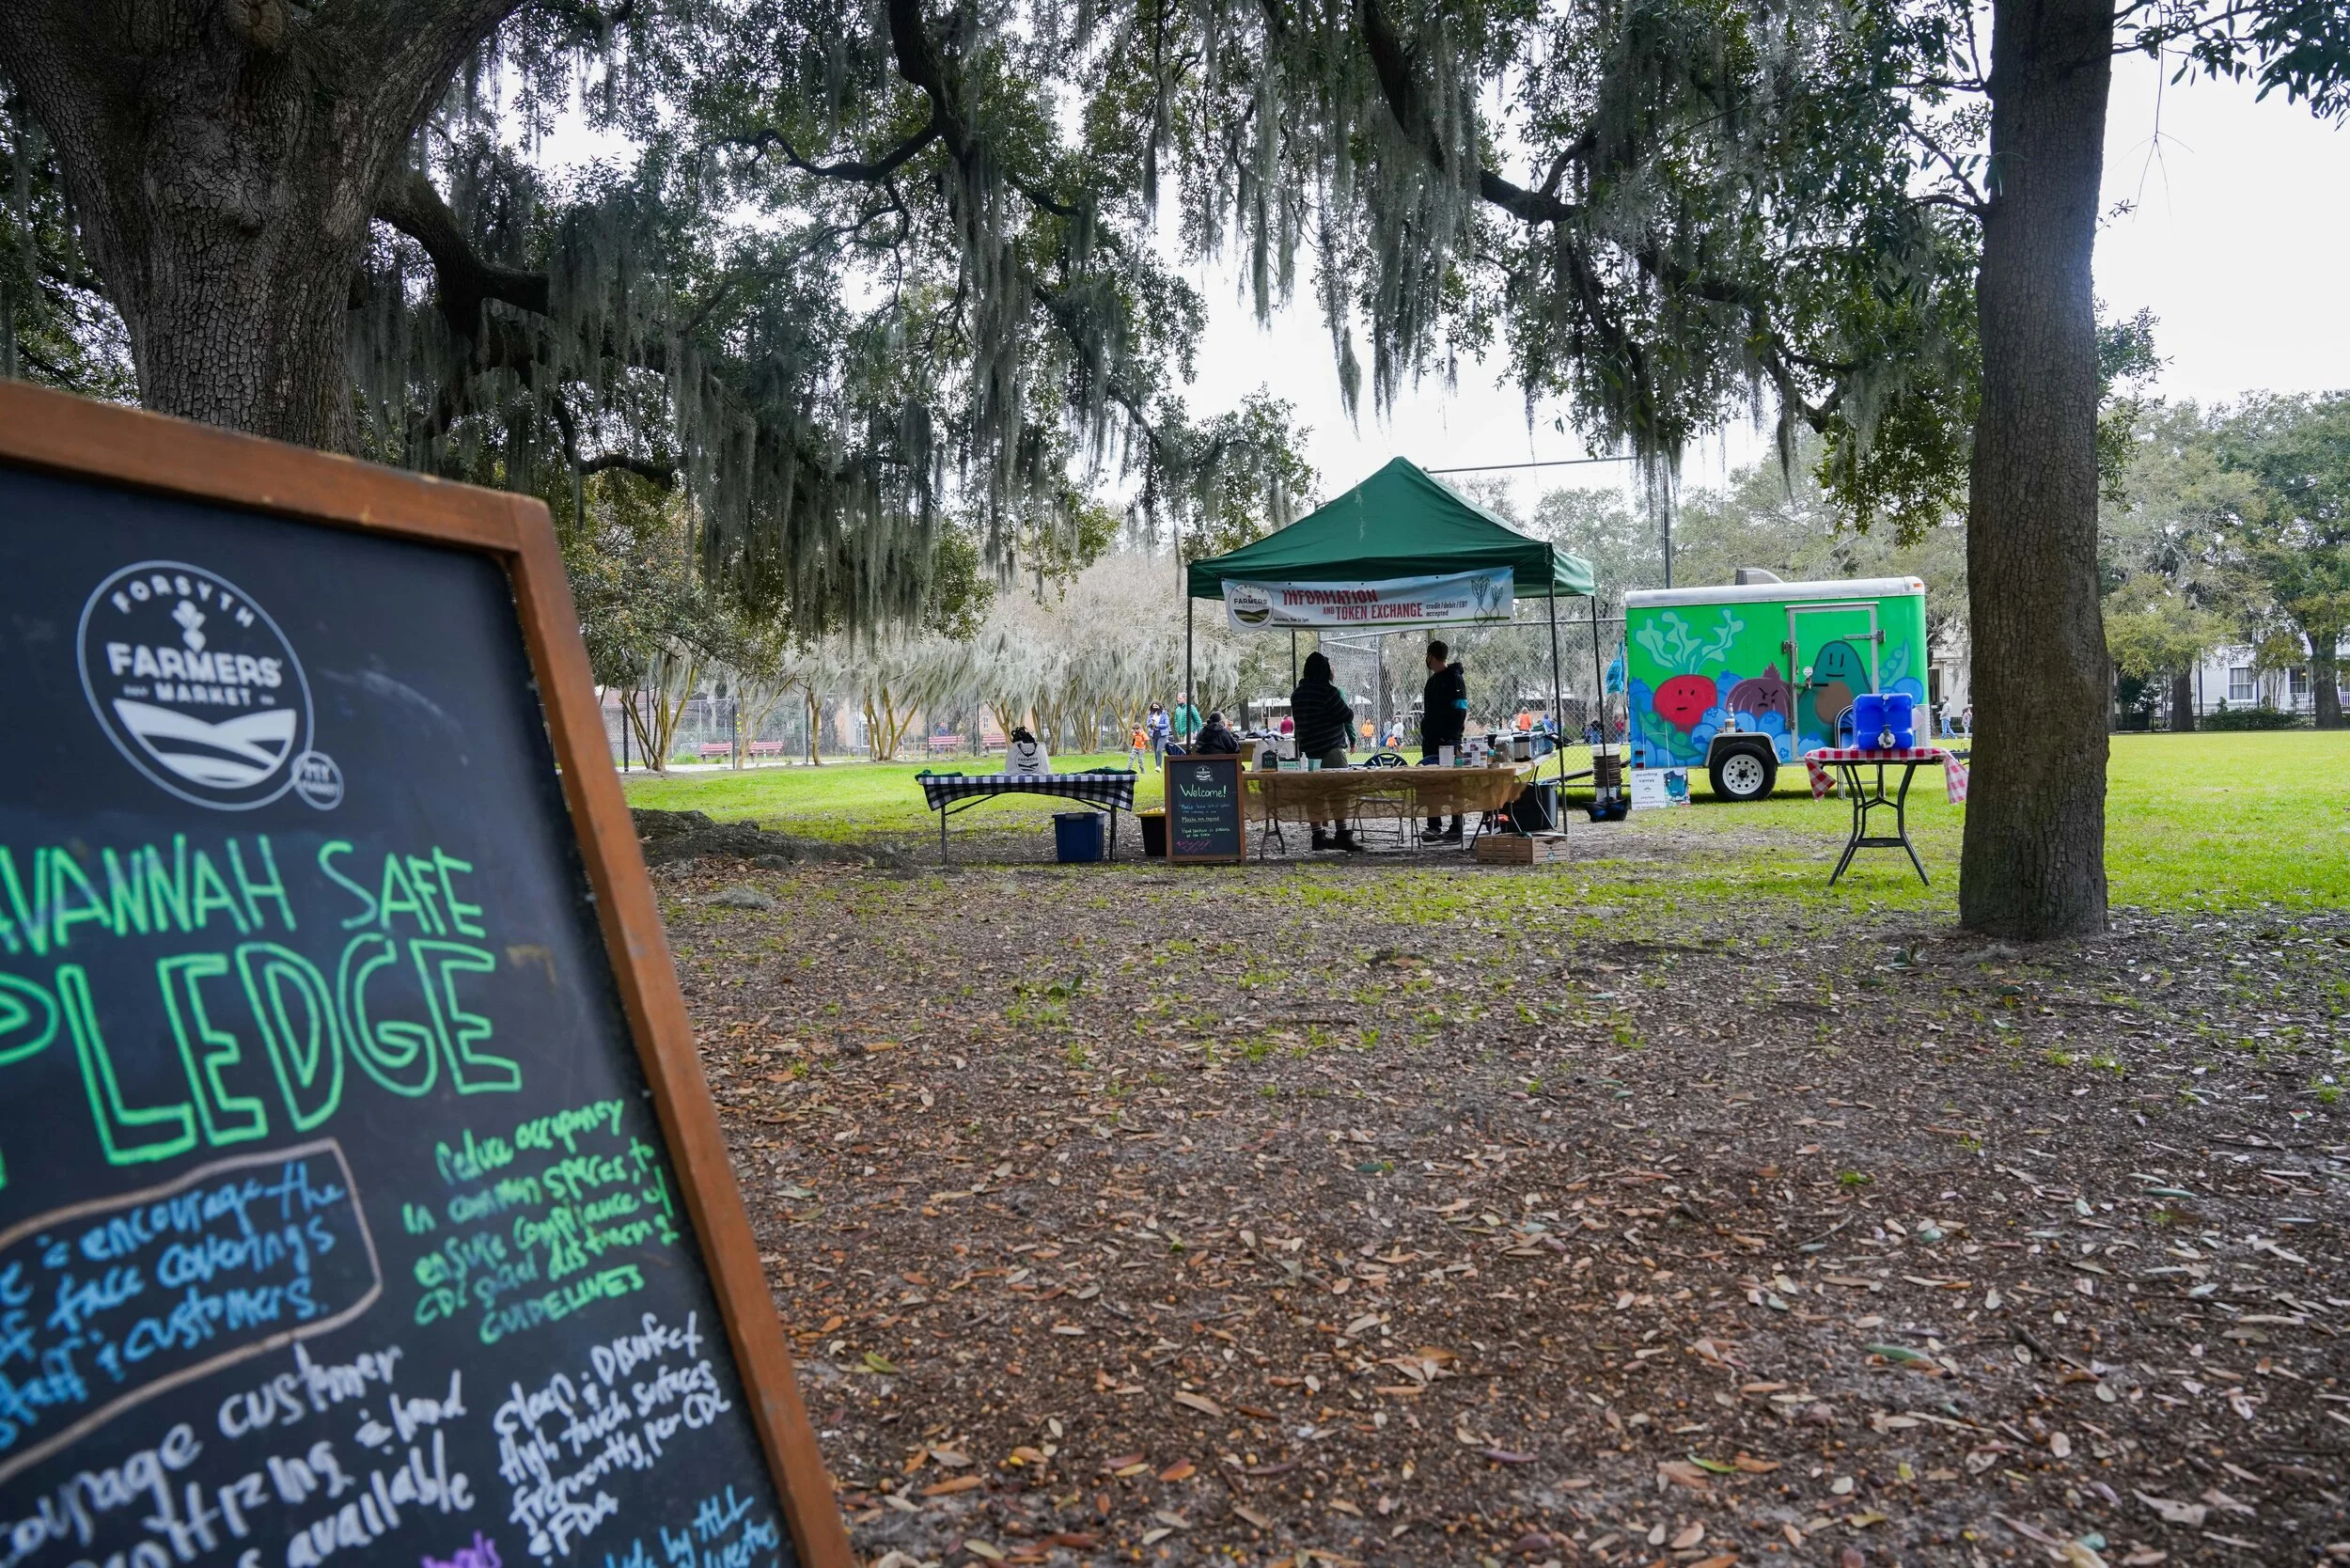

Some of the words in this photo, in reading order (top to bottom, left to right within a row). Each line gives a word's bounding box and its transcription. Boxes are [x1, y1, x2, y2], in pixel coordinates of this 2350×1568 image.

[112, 574, 256, 628] FORSYTH
[1282, 589, 1378, 605] INFORMATION
[1323, 606, 1335, 615] AND
[1336, 605, 1368, 620] TOKEN
[1371, 603, 1423, 619] EXCHANGE
[154, 682, 251, 706] MARKET
[1180, 784, 1227, 798] Welcome!
[319, 840, 486, 939] SAFE
[390, 1369, 467, 1443] hand
[559, 1389, 632, 1457] touch
[0, 1423, 202, 1568] ourage
[218, 1341, 403, 1438] customer
[287, 1428, 475, 1568] available
[547, 1489, 619, 1557] FDA
